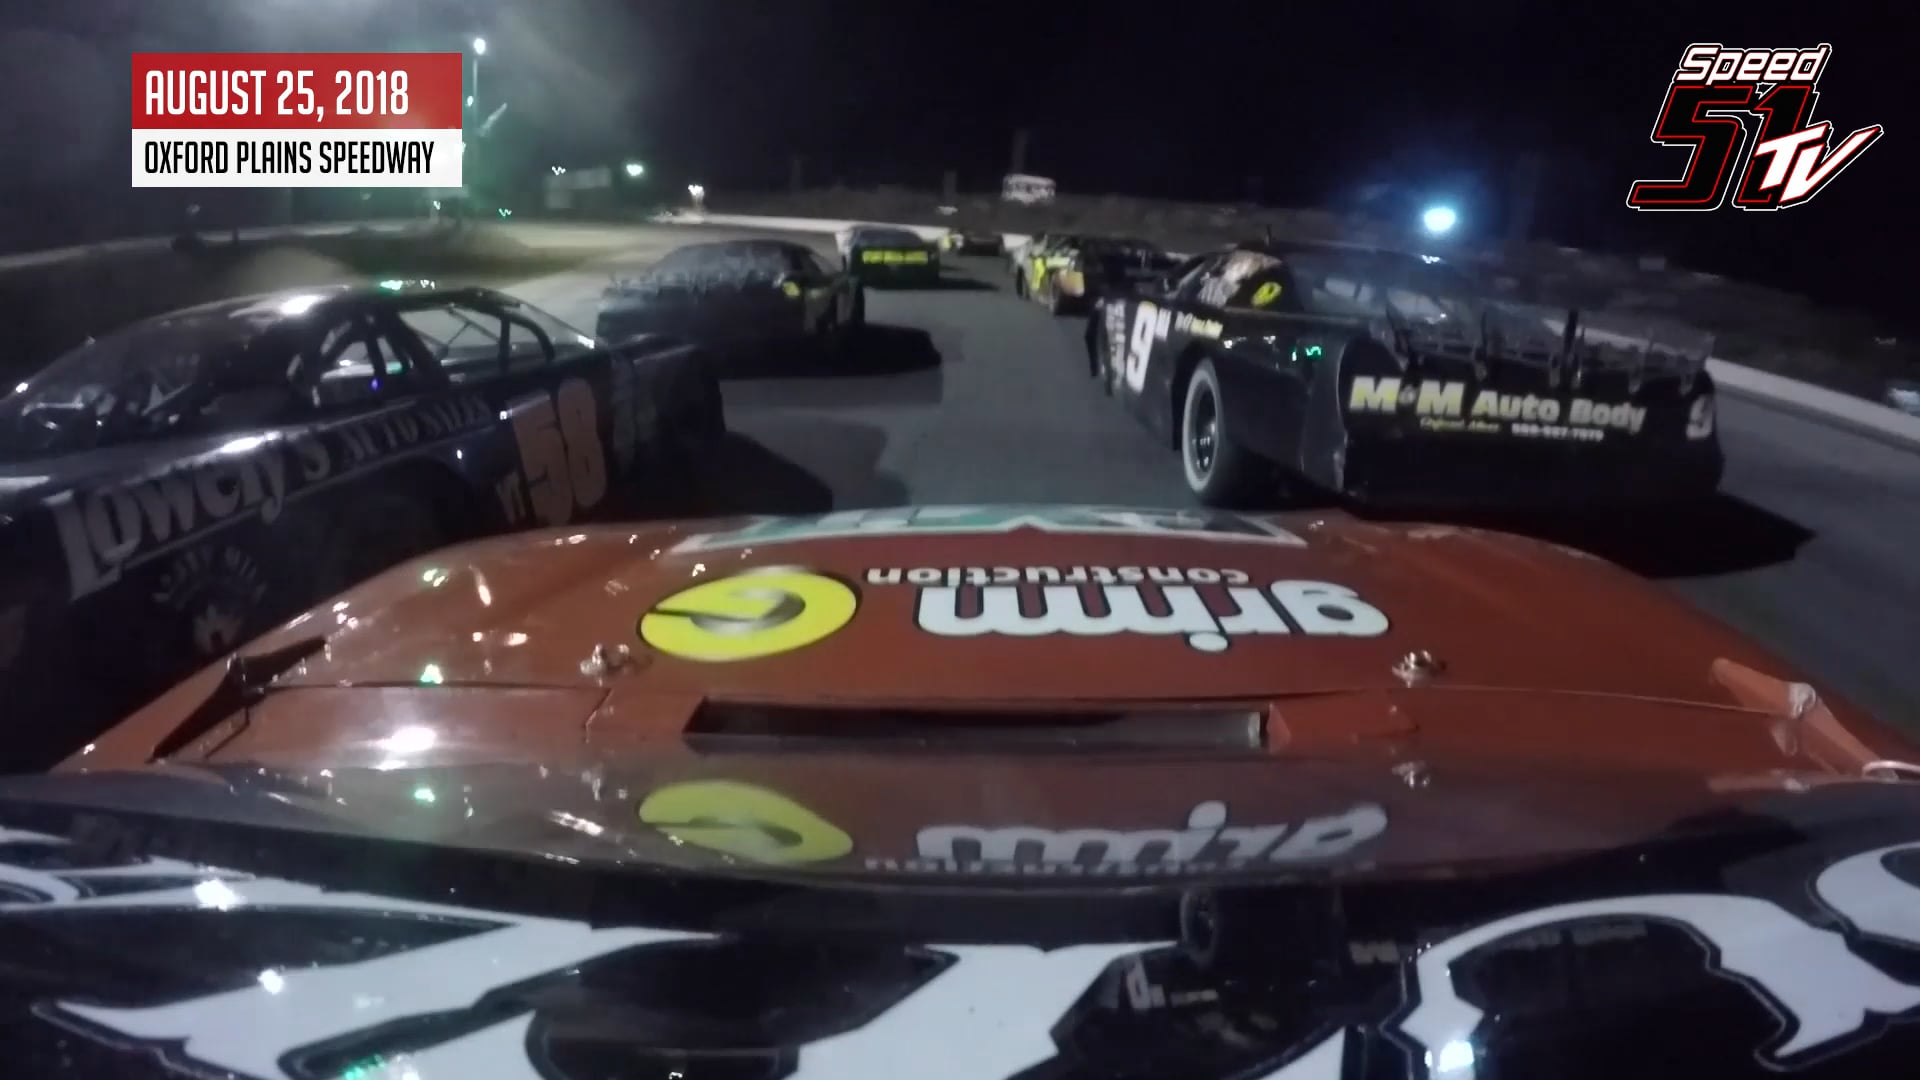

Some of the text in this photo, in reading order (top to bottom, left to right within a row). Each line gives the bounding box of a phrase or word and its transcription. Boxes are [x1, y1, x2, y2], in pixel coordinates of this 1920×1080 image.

[1471, 391, 1560, 422] Auto
[1569, 398, 1647, 434] Body
[505, 378, 607, 526] 58
[867, 564, 1250, 588] construction
[918, 579, 1391, 653] grimm
